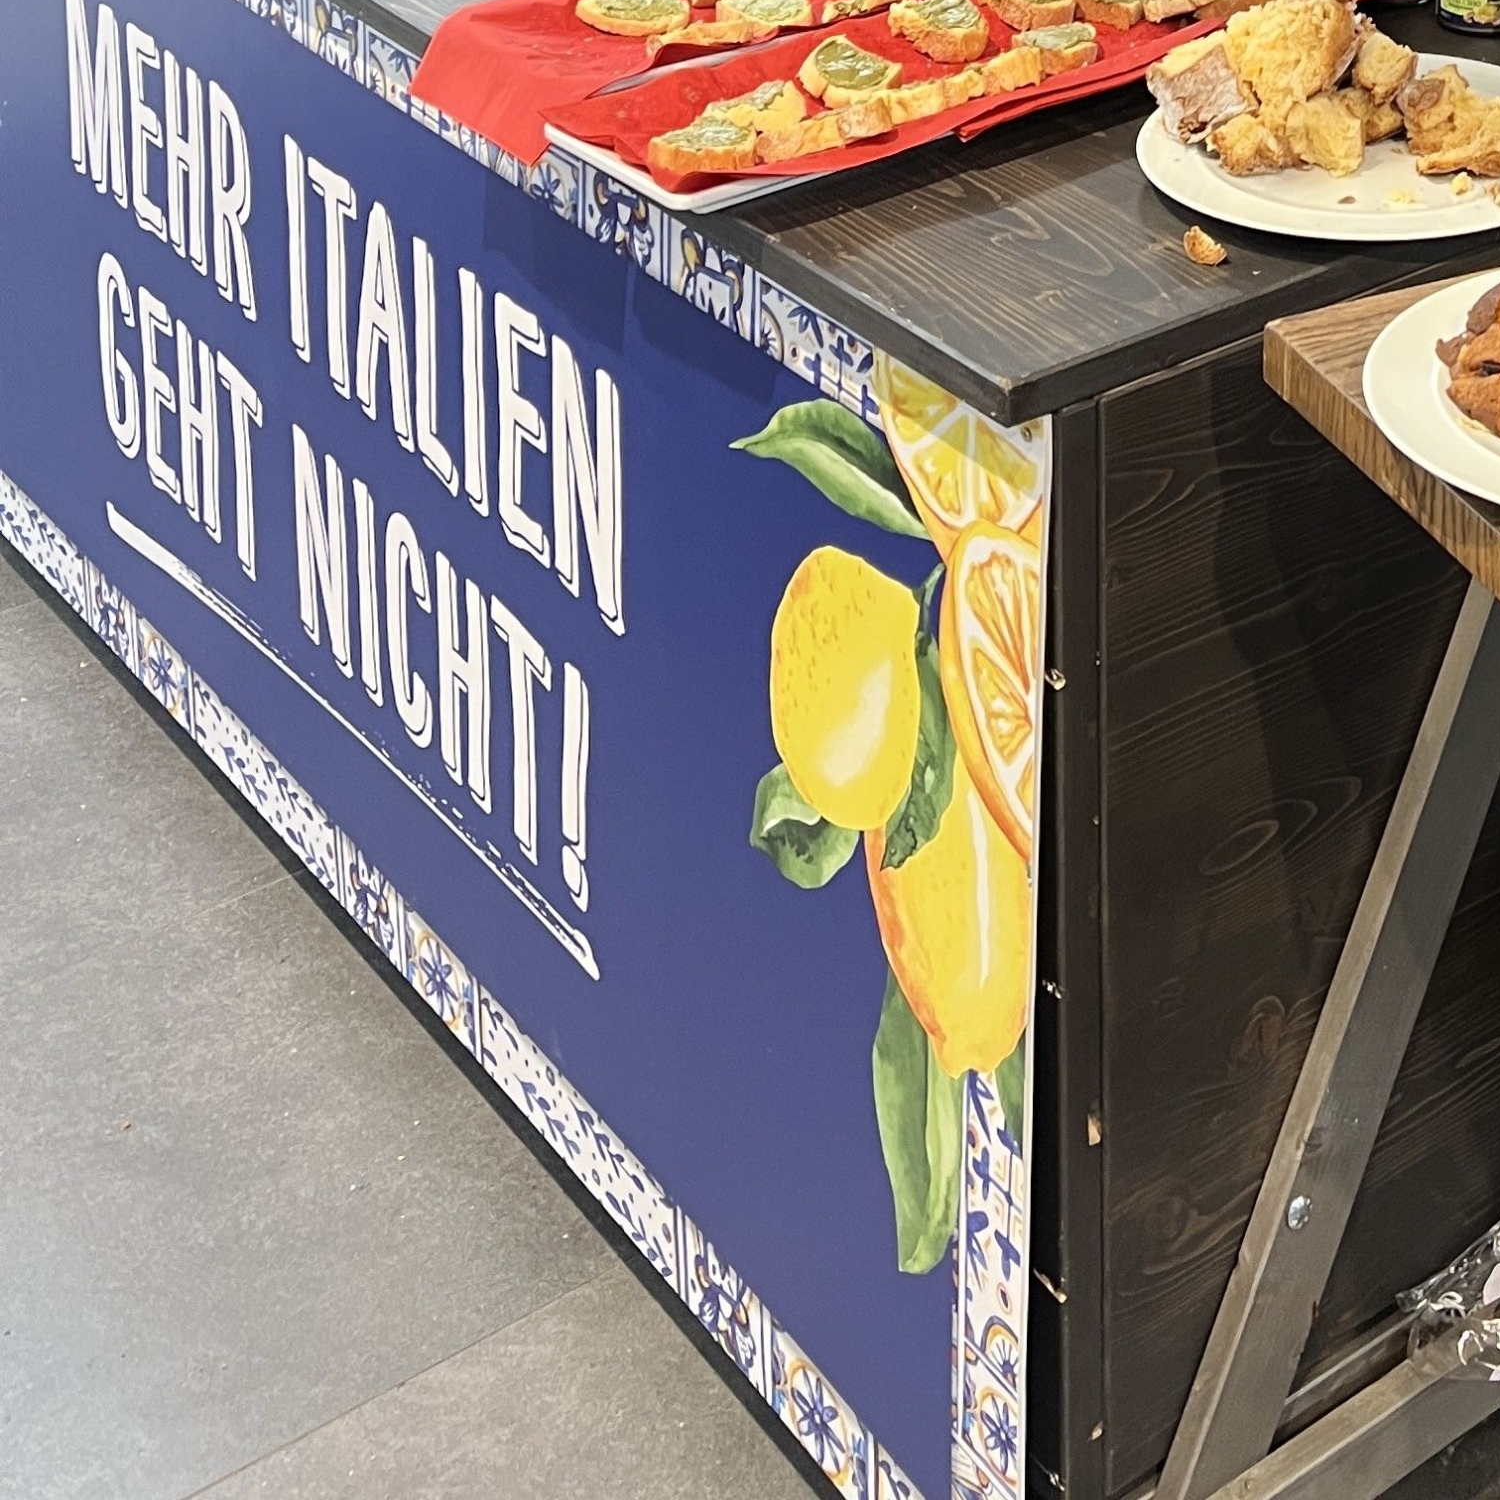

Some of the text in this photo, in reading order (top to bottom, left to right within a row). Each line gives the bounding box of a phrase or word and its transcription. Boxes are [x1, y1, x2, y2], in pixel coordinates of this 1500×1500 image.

[96, 250, 592, 913] GEHT NICHT!
[283, 133, 626, 637] ITALIEN
